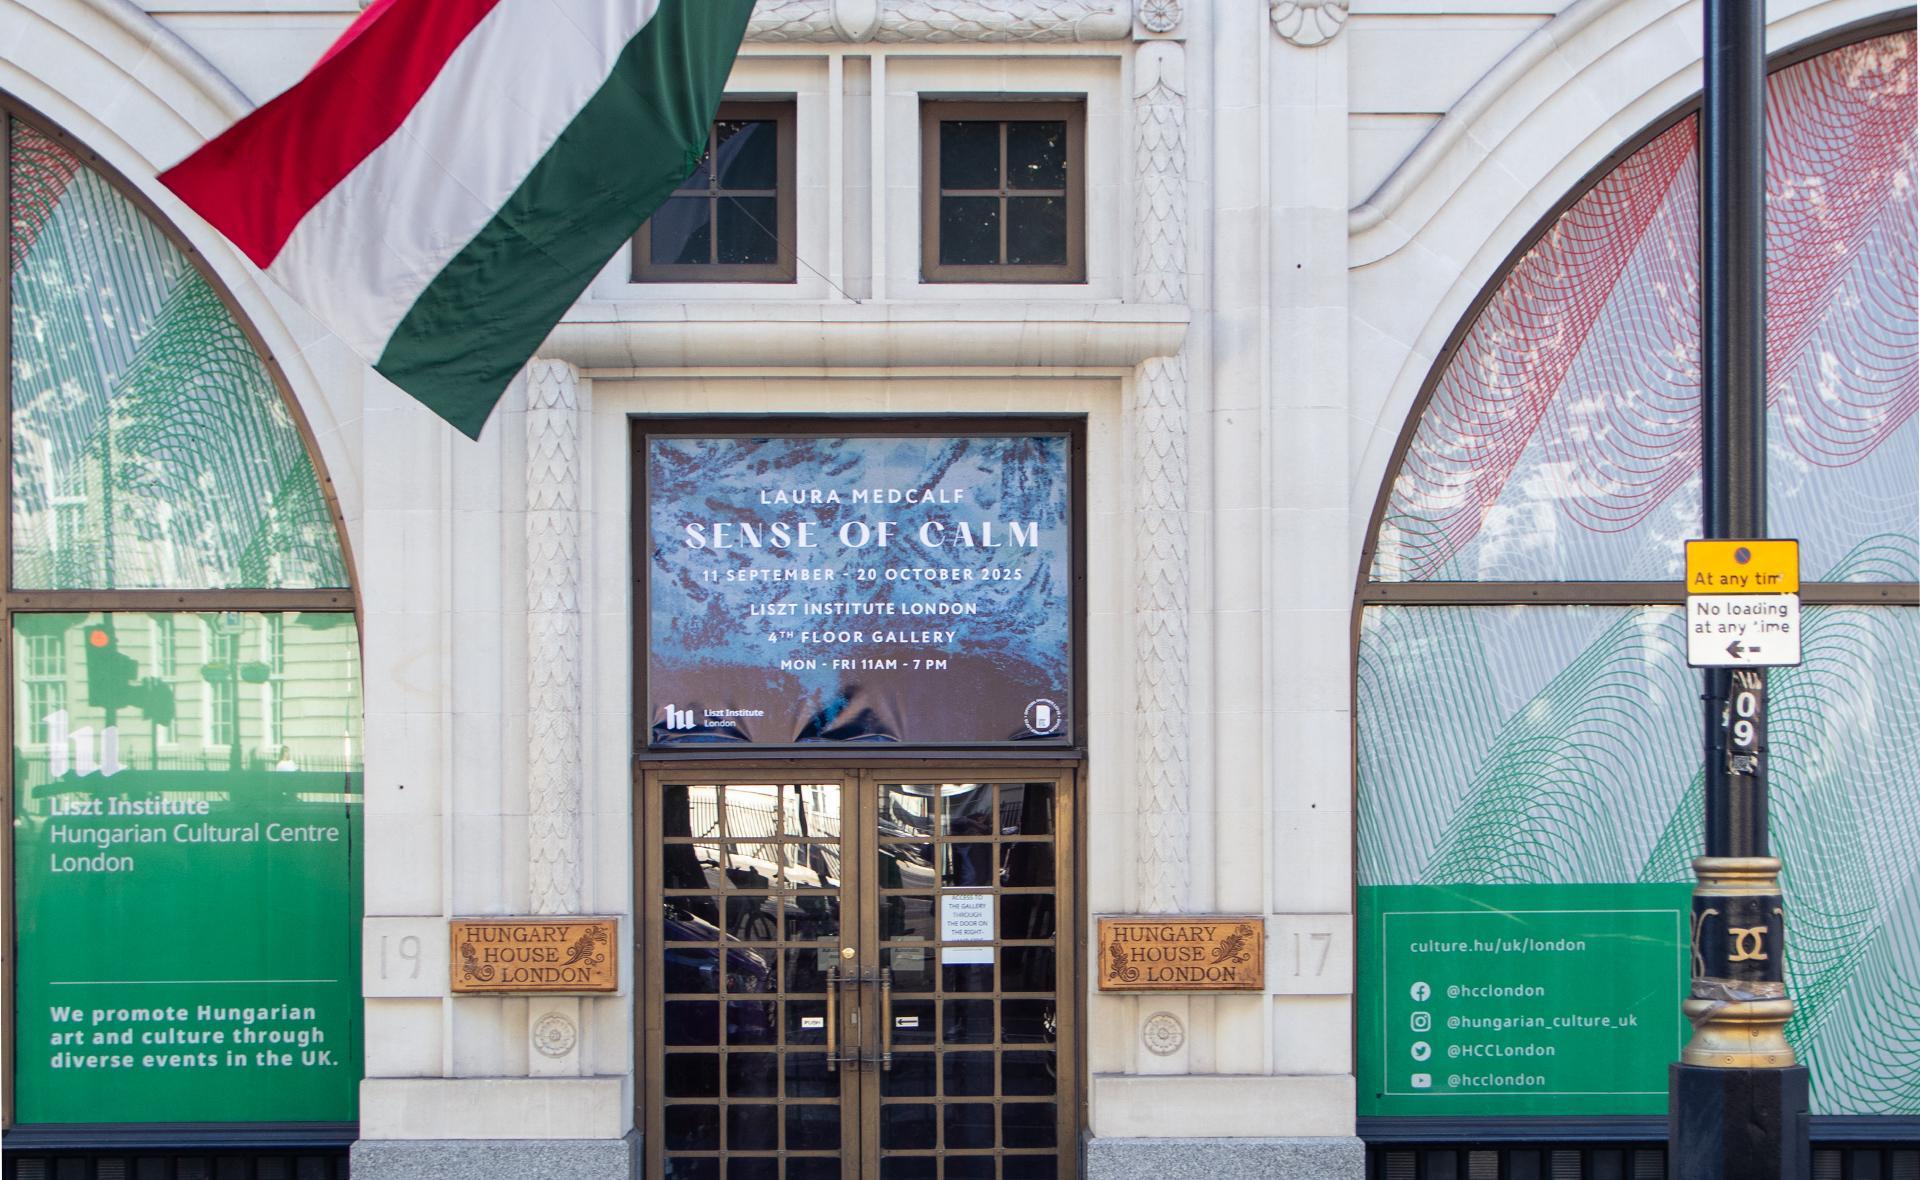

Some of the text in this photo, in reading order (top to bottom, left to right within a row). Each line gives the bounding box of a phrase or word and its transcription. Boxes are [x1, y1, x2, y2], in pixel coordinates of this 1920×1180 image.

[760, 489, 964, 505] LAURA MEDCALF
[685, 521, 1039, 549] SENSE OF CALM
[702, 569, 718, 582] 11
[726, 569, 834, 581] SEPTEMBER
[857, 568, 877, 581] 20
[885, 568, 974, 580] OCTOBER
[981, 568, 1022, 580] 2025
[1694, 572, 1713, 586] At
[1720, 574, 1748, 588] any
[750, 603, 977, 616] LISZT INSTITUTE LONDON
[1697, 602, 1788, 618] No loading
[1695, 620, 1790, 636] at any ime
[768, 631, 956, 644] 4TH FLOOR GALLERY
[781, 659, 816, 670] MON
[832, 659, 856, 670] FRI
[861, 659, 897, 670] 11AM
[913, 659, 921, 670] 7
[926, 659, 947, 670] PM
[704, 709, 765, 717] Liszt Institute
[704, 719, 736, 728] London
[50, 796, 209, 816] Liszt Institute
[50, 822, 339, 849] Hungarian Cultural Centre
[50, 852, 134, 872] London
[466, 927, 570, 943] HUNGARY
[1113, 926, 1217, 942] HUNGARY
[1131, 946, 1206, 962] HOUSE
[1410, 938, 1586, 954] culture.hu/uk/london
[378, 935, 421, 980] 19
[484, 947, 560, 964] HOUSE
[1293, 932, 1332, 977] 17
[502, 967, 592, 983] LONDON
[1146, 966, 1236, 982] LONDON
[1447, 984, 1545, 998] @hcclondon
[50, 1004, 316, 1025] We promote Hungarian
[1447, 1014, 1638, 1031] @hungarian_culture_uk
[50, 1027, 325, 1047] art and culture through
[1447, 1043, 1555, 1057] @HCCLondon
[50, 1050, 338, 1068] diverse events in the UK.
[1448, 1073, 1546, 1087] @hcclondon
